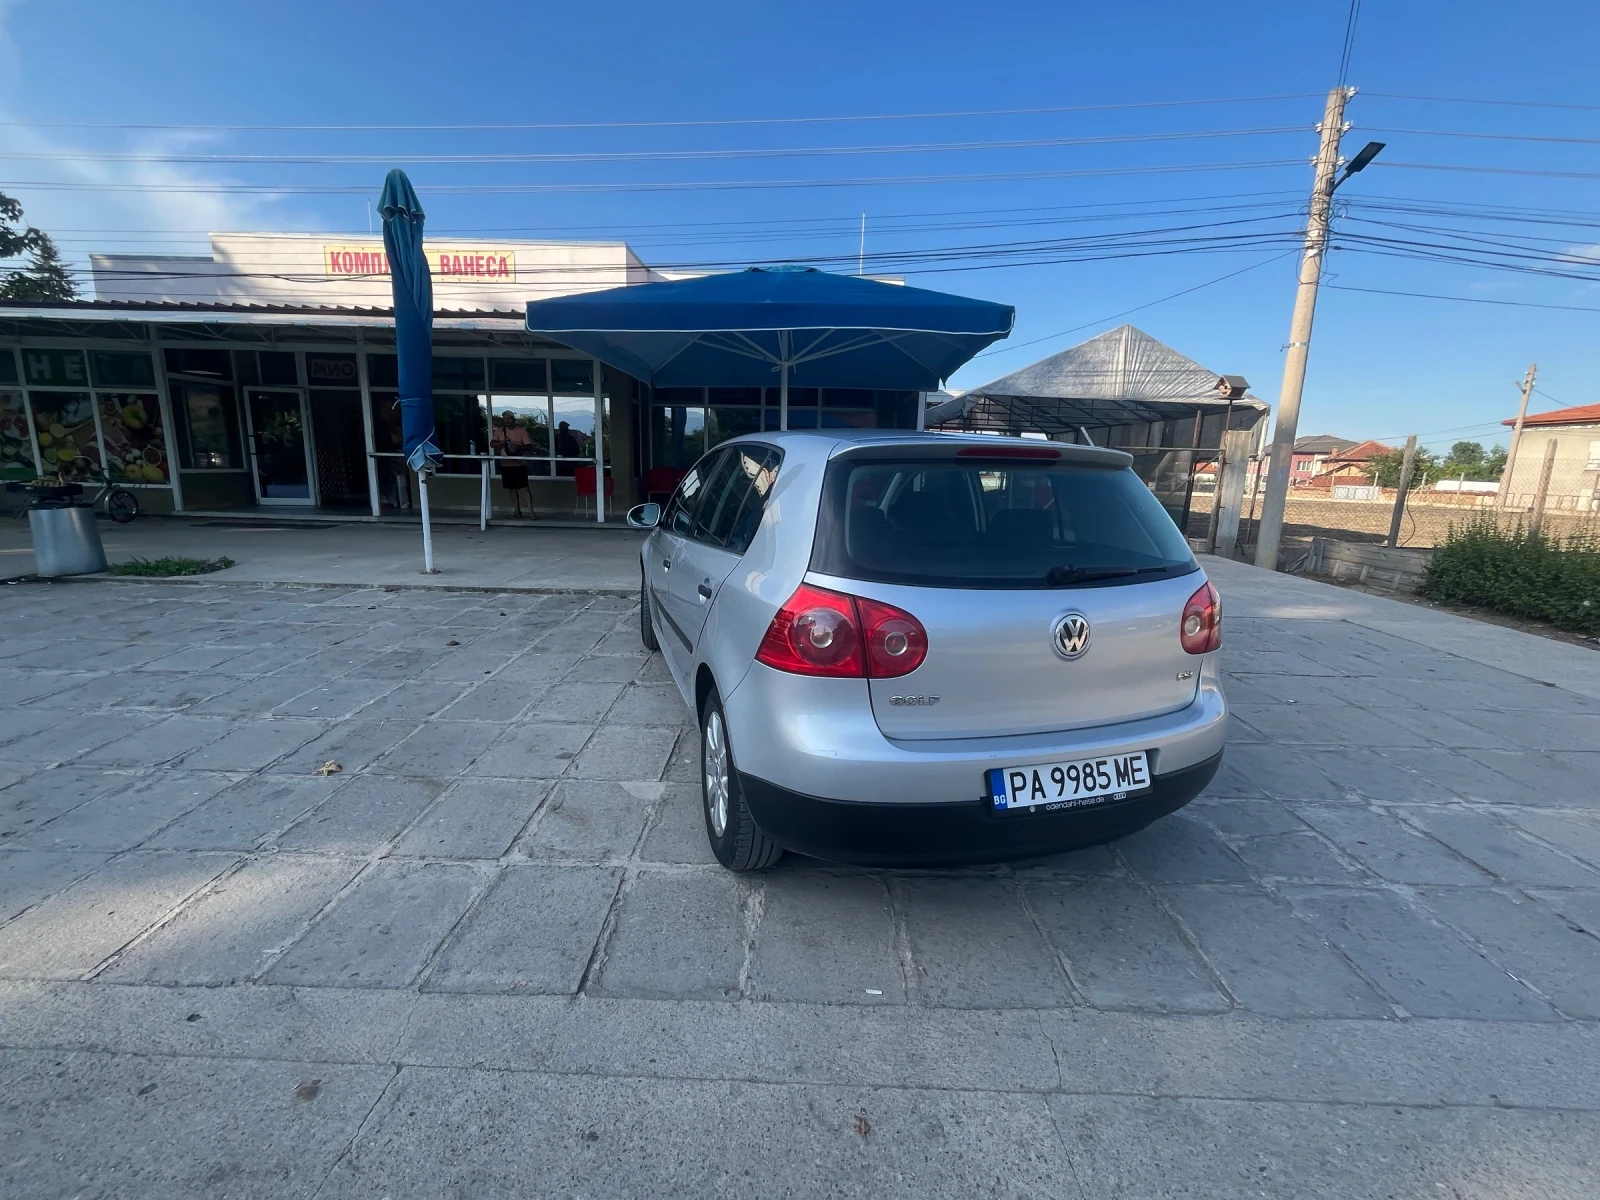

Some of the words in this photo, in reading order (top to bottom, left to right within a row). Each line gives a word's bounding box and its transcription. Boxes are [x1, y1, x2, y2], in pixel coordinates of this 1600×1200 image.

[439, 254, 510, 277] ВАНЕСА
[888, 694, 941, 707] GOLF
[994, 795, 1006, 805] BG
